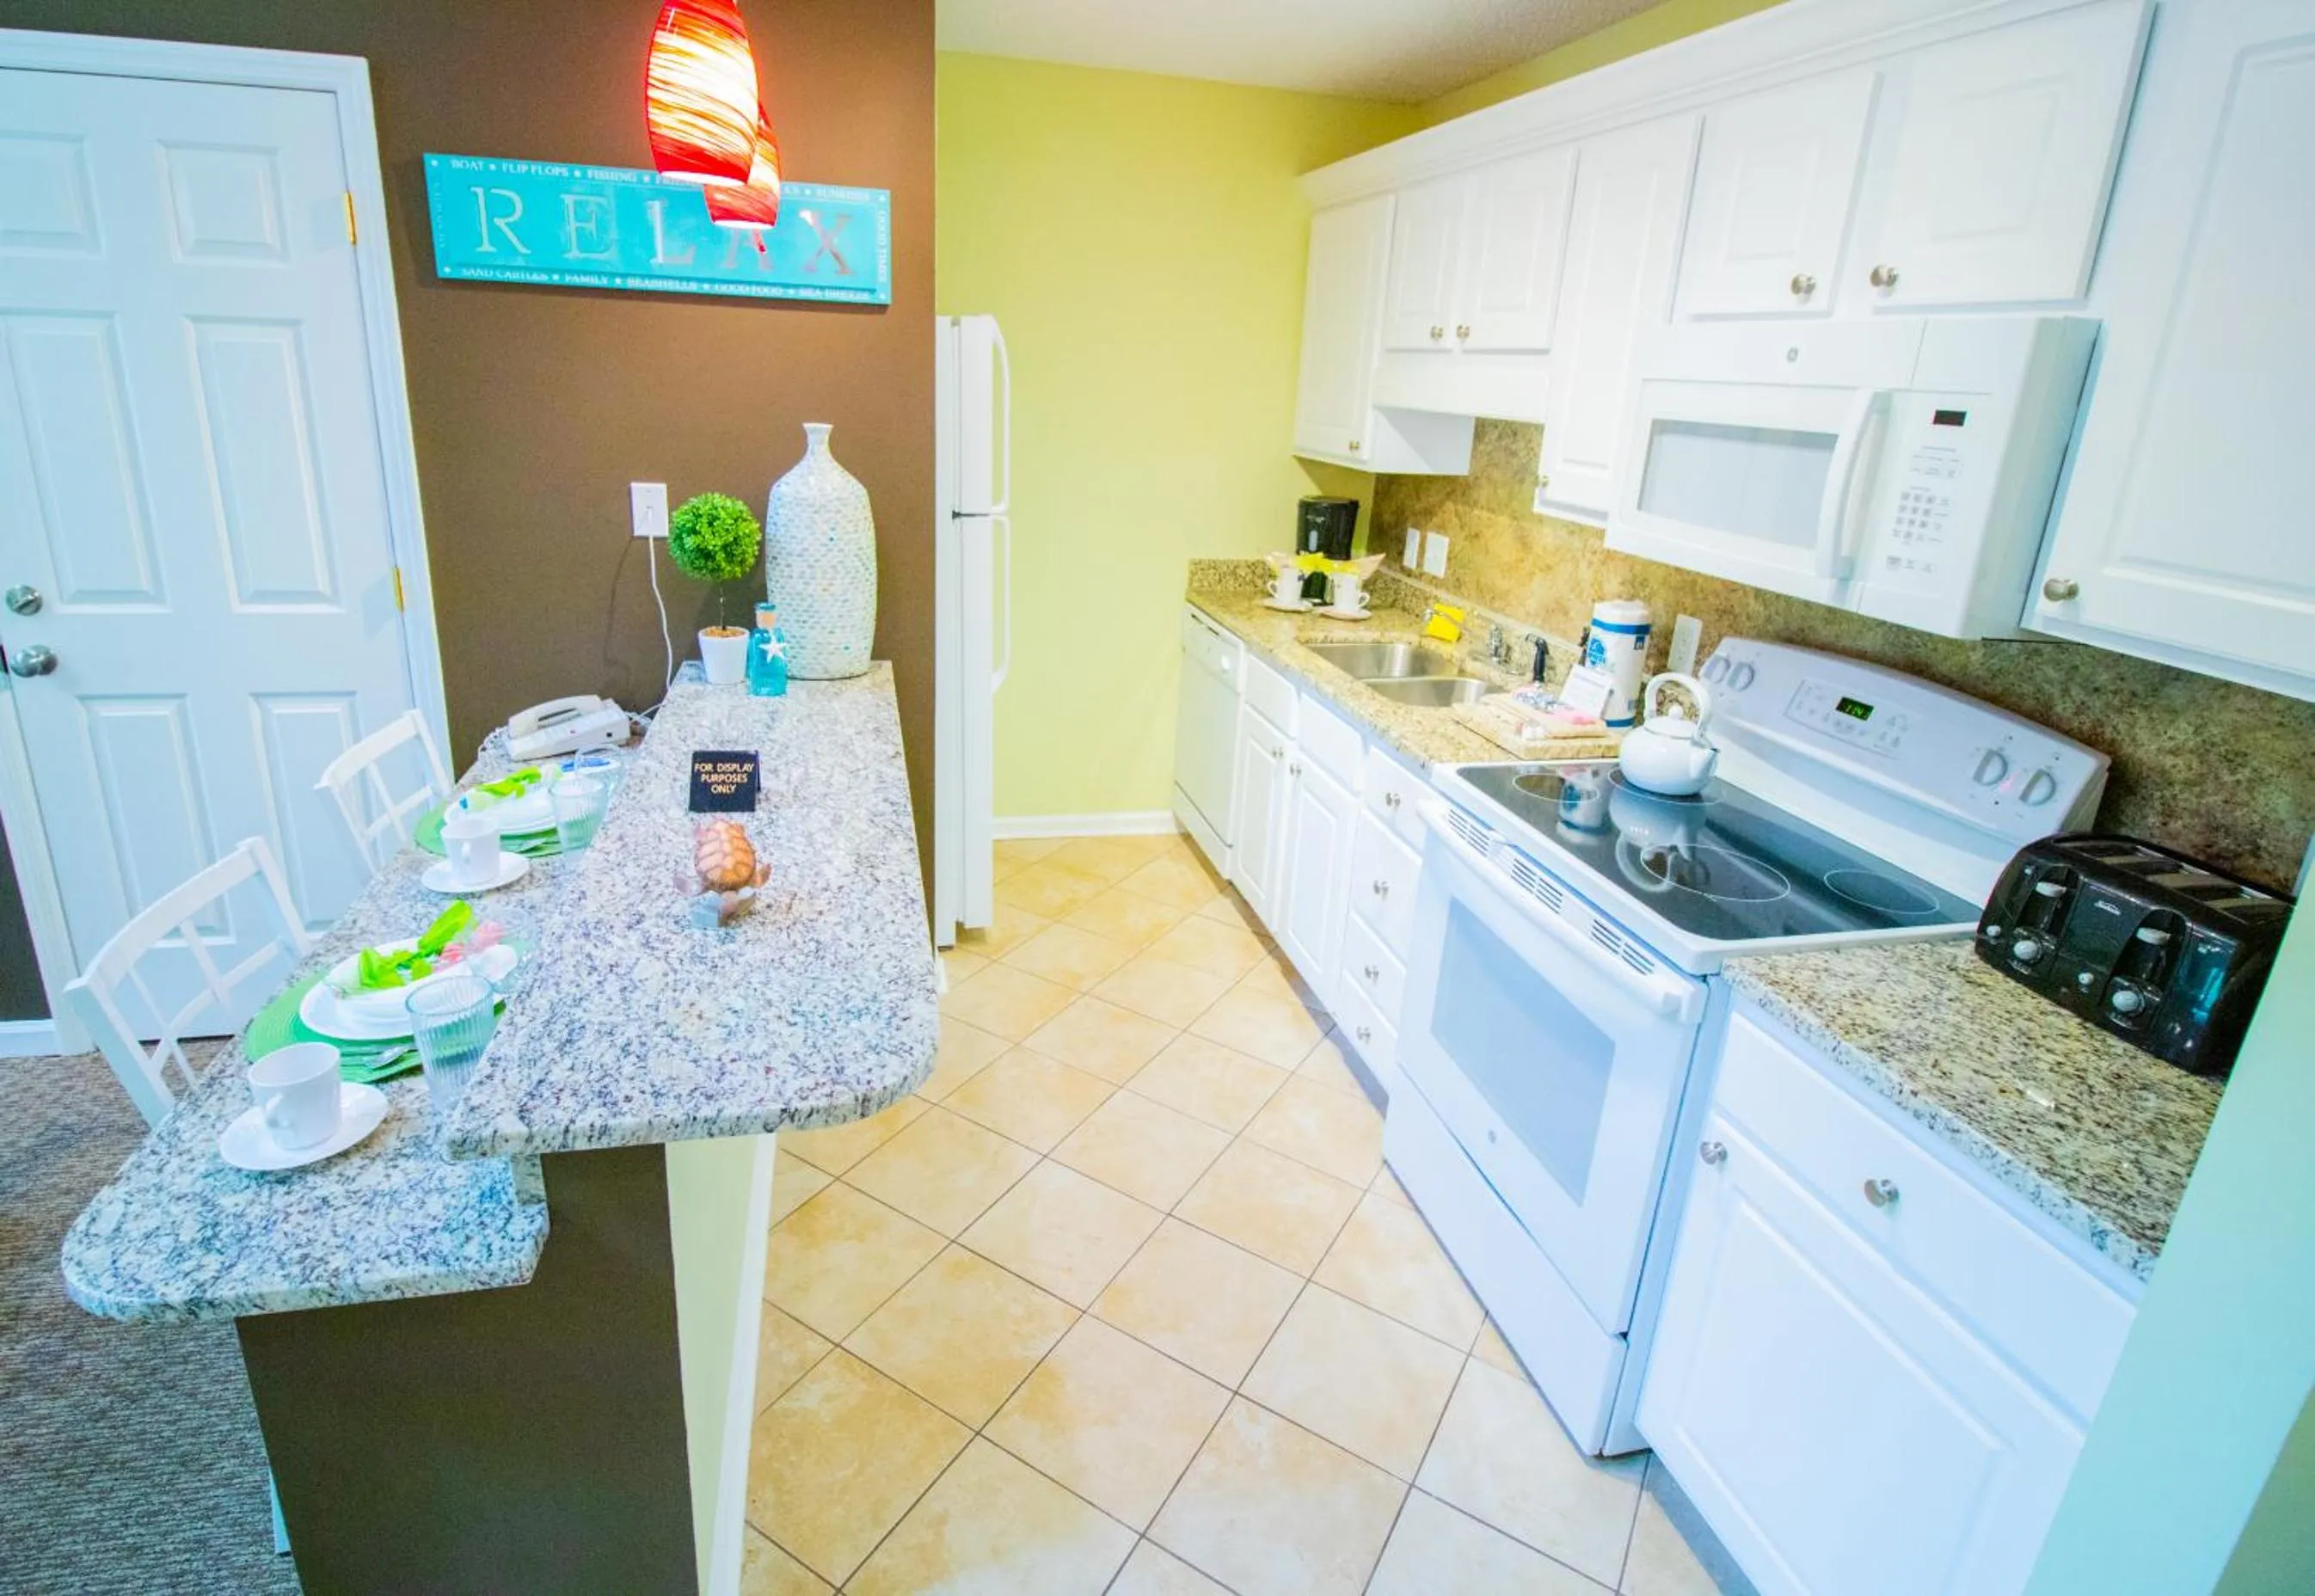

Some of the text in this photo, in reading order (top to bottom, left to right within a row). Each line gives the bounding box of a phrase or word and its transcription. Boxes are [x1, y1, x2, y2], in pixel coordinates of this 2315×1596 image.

[449, 158, 483, 172] BOAT
[501, 161, 528, 175] FLIP
[530, 164, 569, 177] FLOPS
[587, 168, 637, 182] FISHING
[470, 186, 853, 275] RELAX
[461, 267, 494, 278] SAND
[565, 273, 608, 285] FAMILY
[693, 763, 754, 774] FOR DISPLAY
[700, 773, 748, 783] PURPOSES
[710, 783, 737, 795] ONLY
